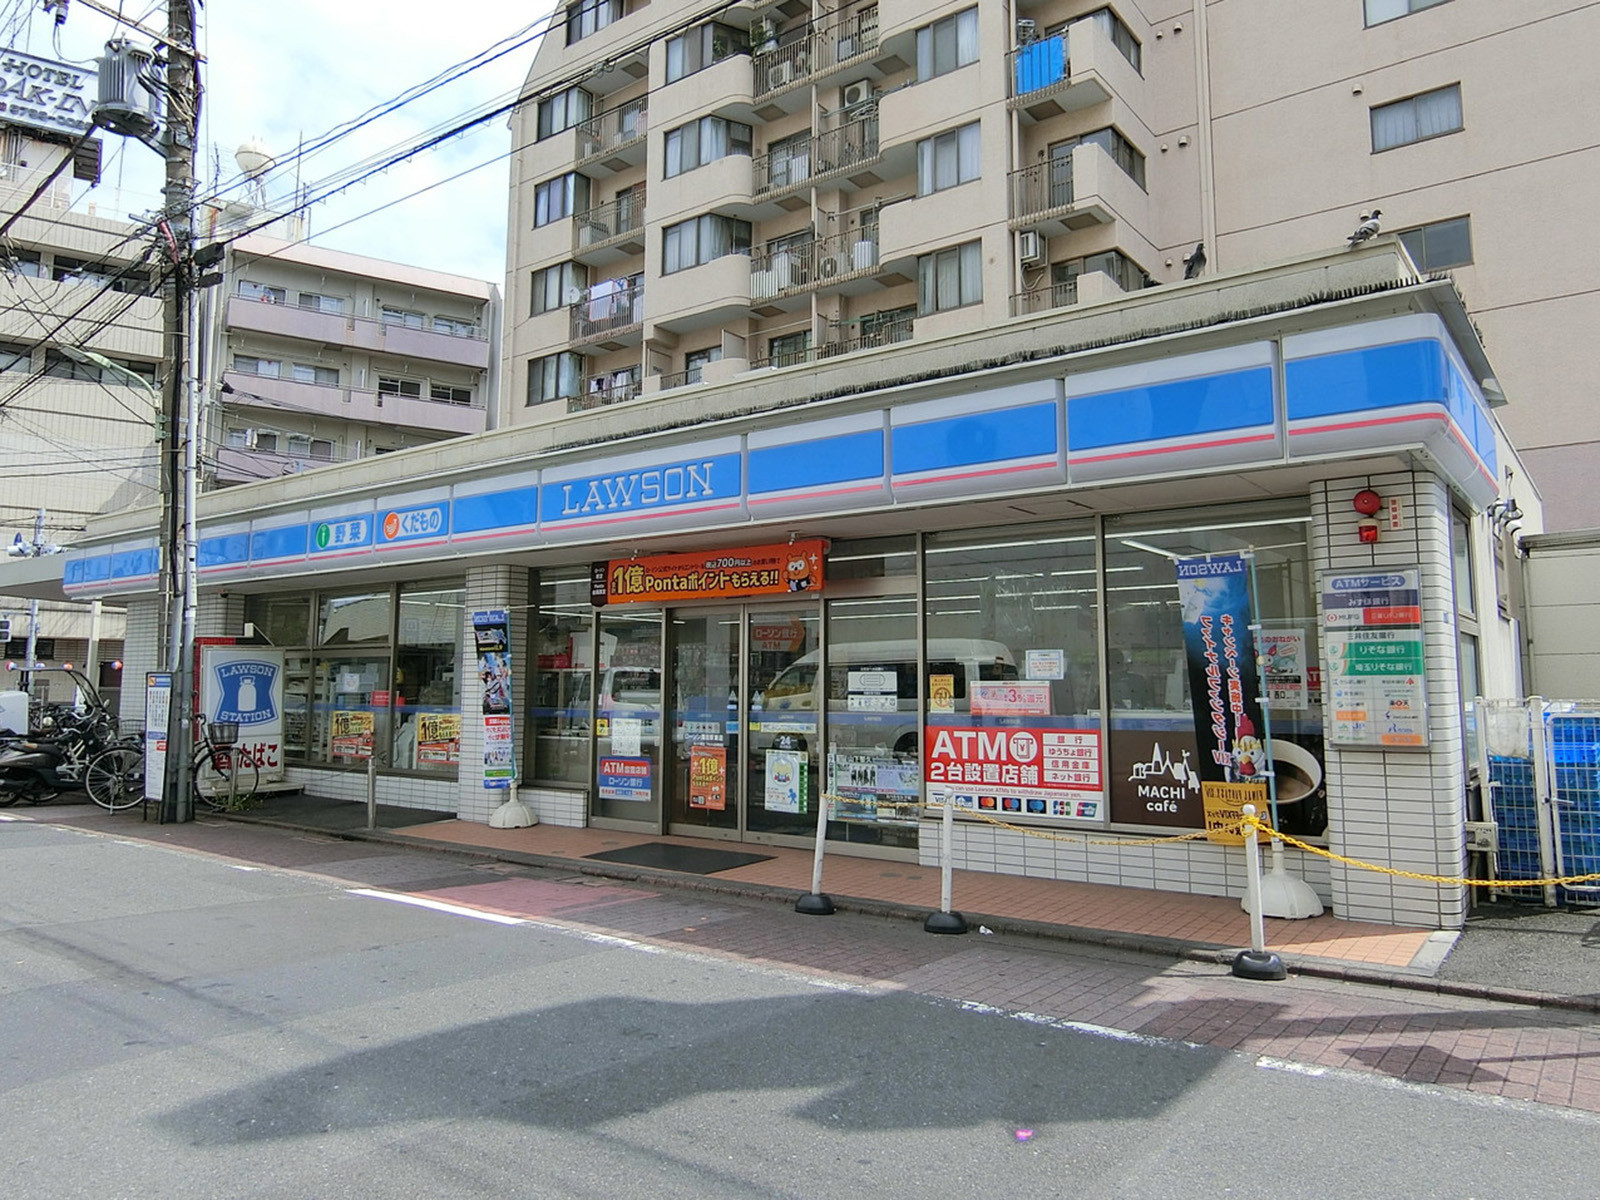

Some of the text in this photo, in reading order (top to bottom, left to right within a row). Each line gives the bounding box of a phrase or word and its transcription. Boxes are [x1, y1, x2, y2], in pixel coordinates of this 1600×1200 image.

[2, 58, 84, 90] HOTEL
[562, 462, 714, 516] LAWSON
[401, 507, 442, 535] くだもの
[334, 523, 362, 544] 野菜
[1334, 576, 1402, 590] ATMサービス
[1348, 632, 1396, 641] 三井住友銀行
[1359, 645, 1406, 655] りそな銀行
[220, 664, 274, 678] LAWSON
[1355, 662, 1414, 672] 埼玉りそな銀行
[220, 709, 273, 723] STATION
[931, 731, 1007, 761] ATM
[1048, 748, 1092, 757] ゆうちょ銀行
[240, 743, 279, 769] たばこ
[1052, 760, 1090, 770] 信用金庫
[930, 763, 1039, 786] 2台設置店舗
[1052, 773, 1091, 782] ネット銀行
[1137, 785, 1186, 799] MACHI
[1146, 799, 1178, 813] café
